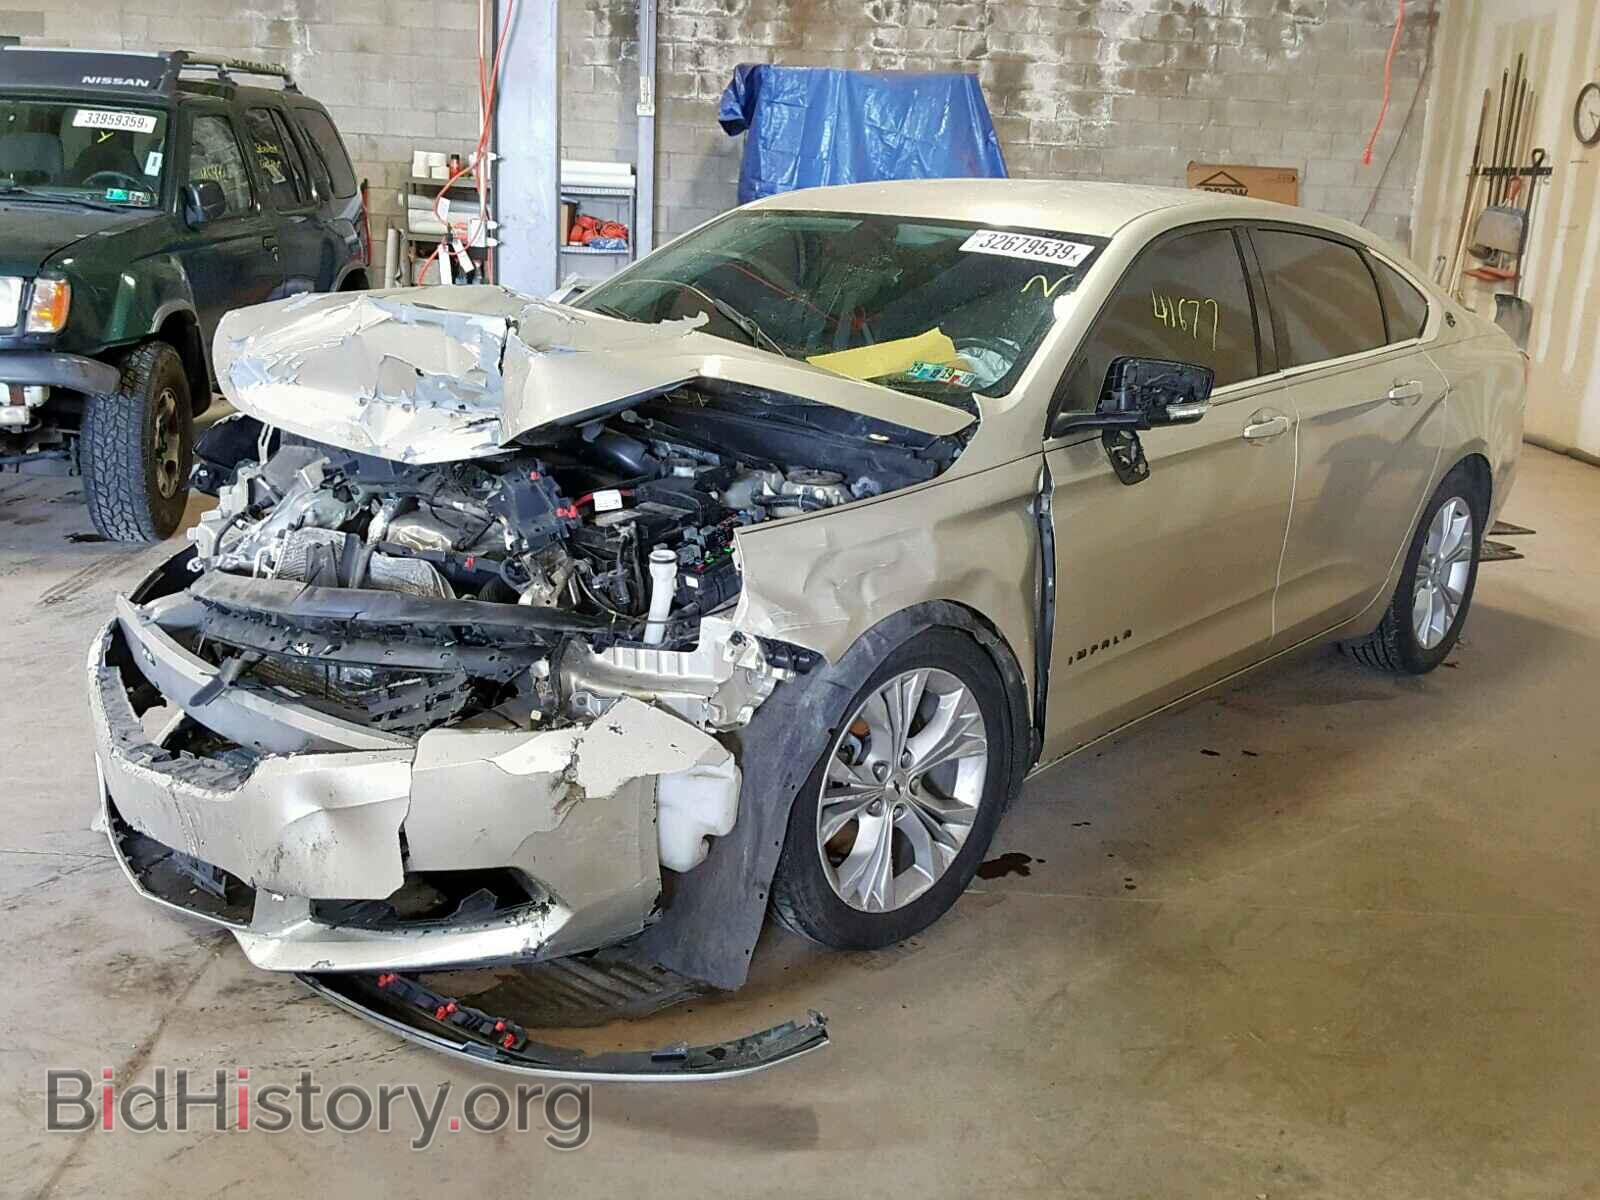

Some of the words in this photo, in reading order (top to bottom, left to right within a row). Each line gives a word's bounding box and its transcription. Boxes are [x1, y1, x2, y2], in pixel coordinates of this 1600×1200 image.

[82, 76, 149, 87] NISSAN
[980, 234, 1075, 260] 32679539
[1151, 287, 1218, 351] 41677
[1067, 628, 1133, 666] IMPALA
